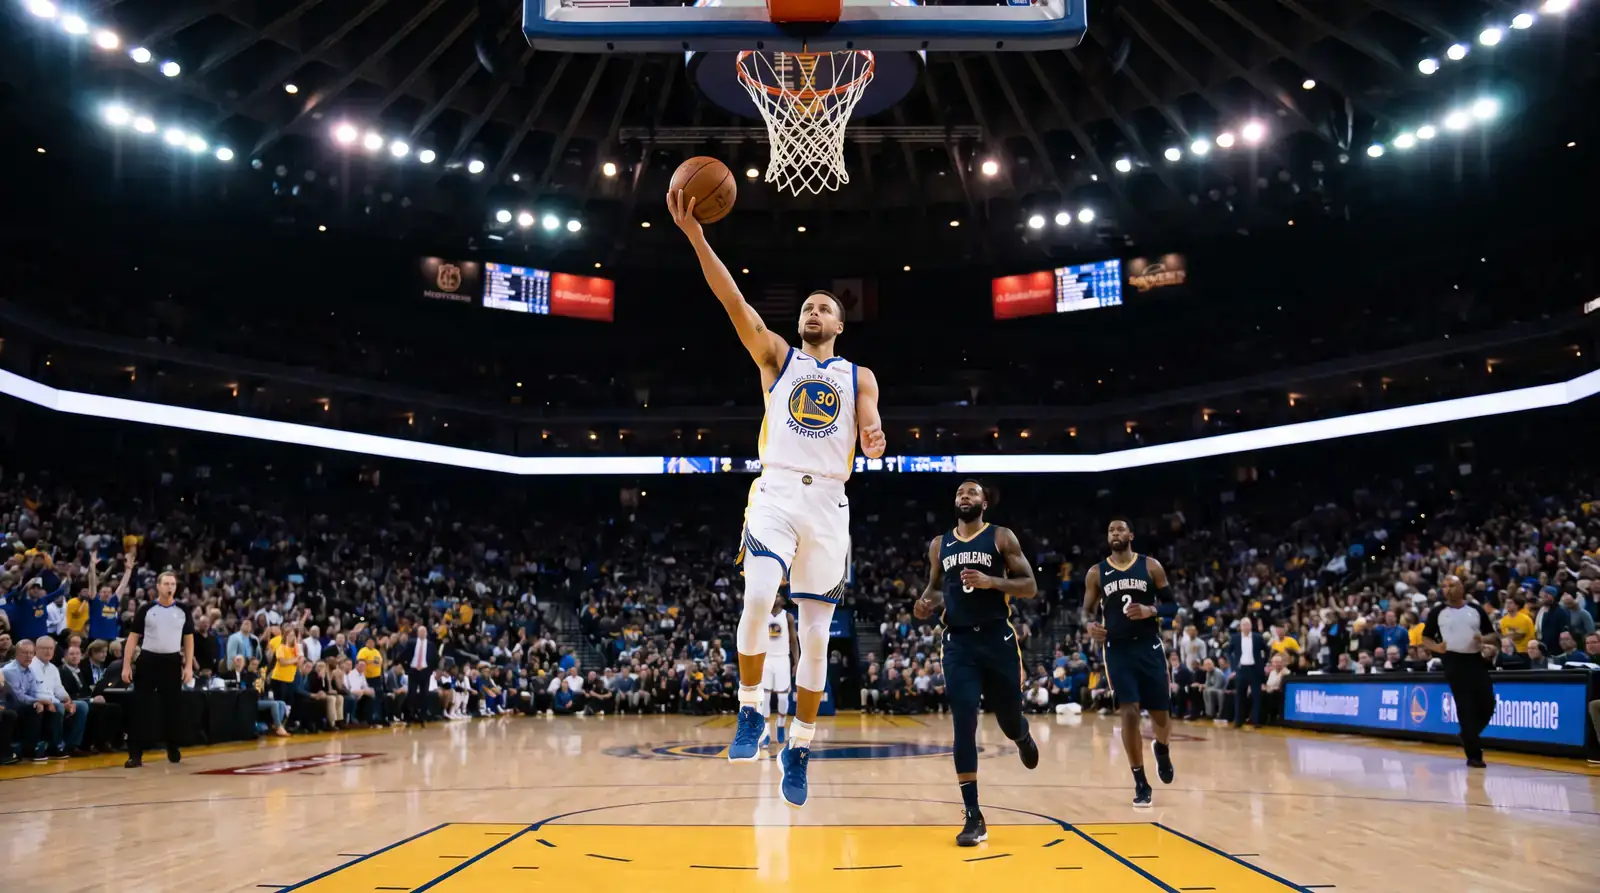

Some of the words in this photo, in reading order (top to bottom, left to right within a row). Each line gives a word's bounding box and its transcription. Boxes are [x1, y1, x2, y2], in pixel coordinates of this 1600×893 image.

[791, 374, 823, 387] GOLDEN
[825, 377, 844, 395] STATE
[815, 391, 835, 407] 30
[786, 417, 838, 439] WARRIORS
[942, 553, 958, 572] NEW
[958, 551, 992, 568] ORLEANS
[1103, 580, 1118, 597] NEW
[1118, 578, 1148, 593] ORLEANS
[1121, 594, 1132, 614] 2
